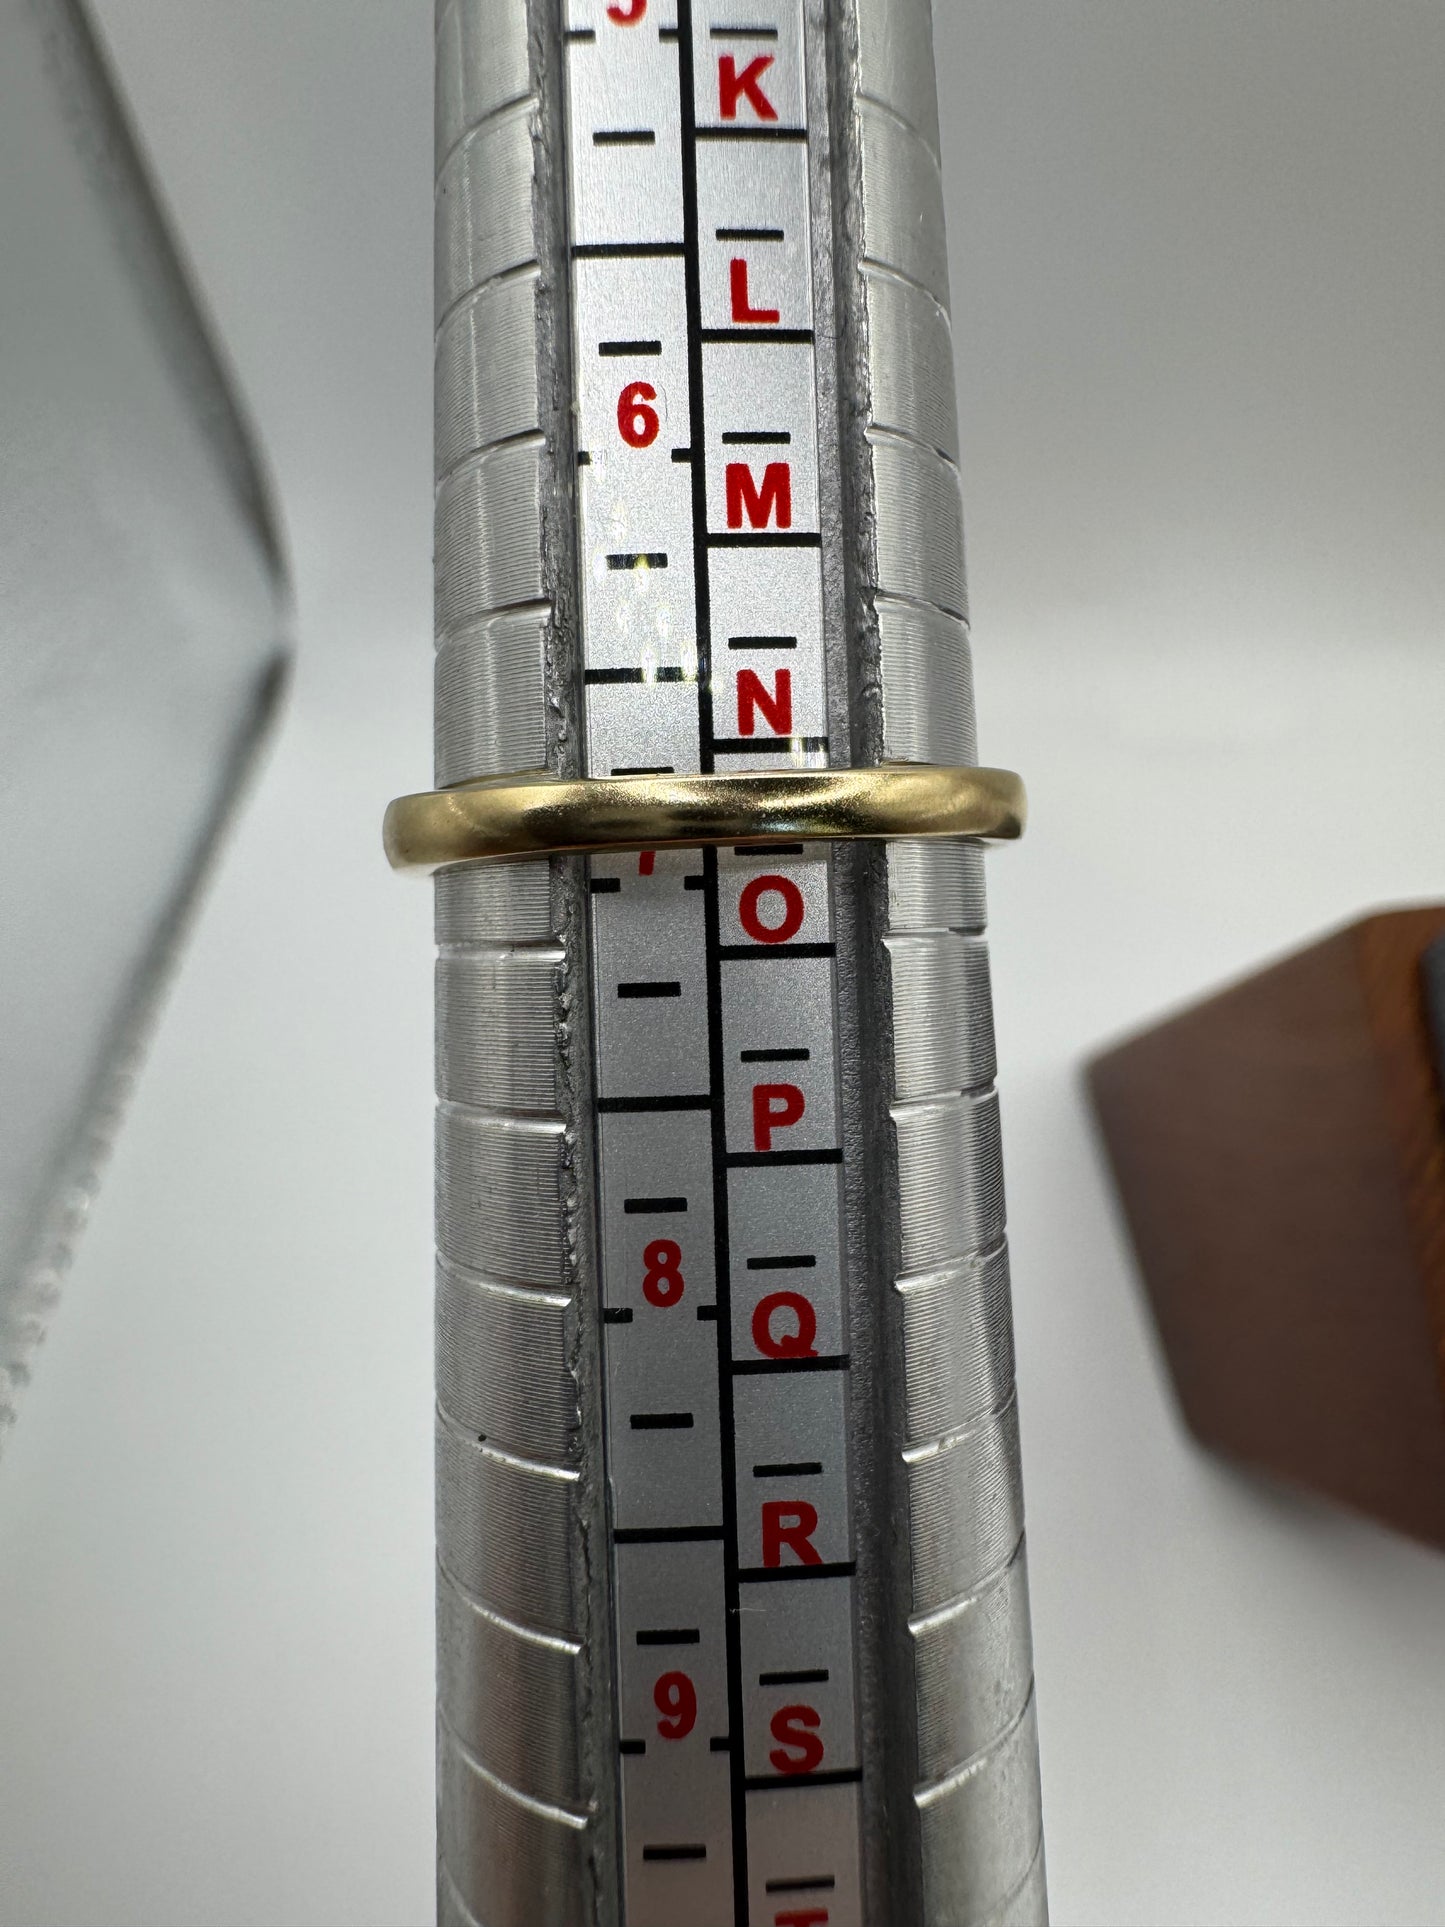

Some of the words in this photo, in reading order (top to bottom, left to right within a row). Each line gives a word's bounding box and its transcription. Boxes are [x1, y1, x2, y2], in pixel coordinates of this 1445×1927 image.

[718, 55, 778, 121] K
[729, 258, 780, 323] L
[617, 381, 660, 447] 6
[726, 463, 791, 529] M
[737, 669, 792, 736] N
[738, 874, 805, 944] O
[752, 1083, 805, 1152] P
[642, 1239, 685, 1308] 8
[751, 1291, 821, 1362] Q
[762, 1500, 828, 1570] R
[653, 1670, 698, 1741] 9
[769, 1704, 825, 1782] S
